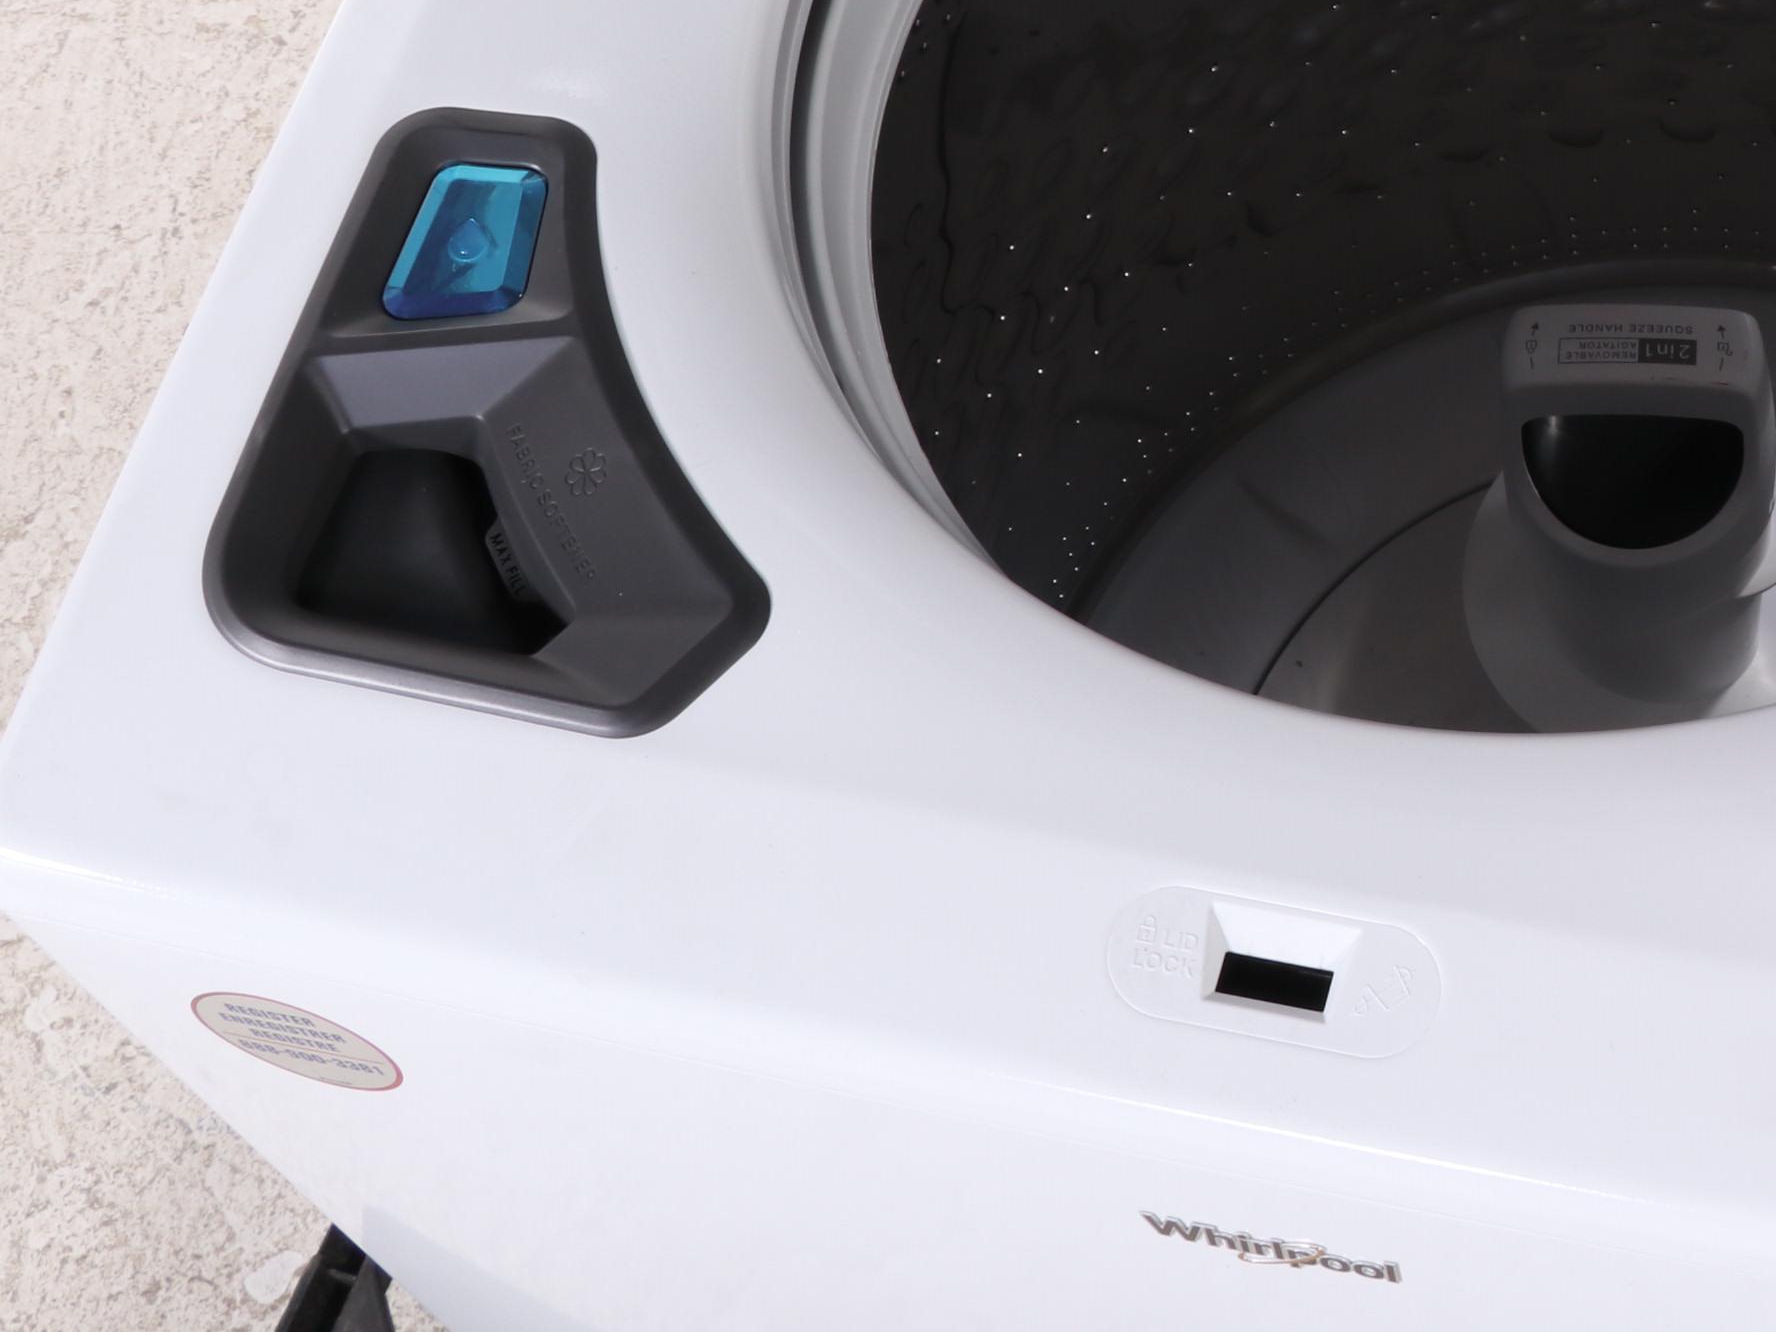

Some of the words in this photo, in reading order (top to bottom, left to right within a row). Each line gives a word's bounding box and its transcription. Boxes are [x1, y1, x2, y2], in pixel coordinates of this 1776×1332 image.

[1568, 323, 1623, 333] HANDLE
[1629, 324, 1694, 335] SQUEEZE
[1565, 351, 1637, 360] REMOVABLE
[1579, 341, 1637, 350] AGITATOR
[506, 423, 543, 490] FABRIC
[537, 488, 597, 582] SOFTENER
[489, 532, 512, 566] MAX
[505, 567, 527, 597] FILL
[1162, 928, 1199, 953] LID
[1131, 947, 1198, 979] LOCK
[217, 1012, 347, 1044] ENREGISTRER
[224, 1003, 316, 1028] REGISTER
[250, 1029, 341, 1052] REGISTRE
[1138, 1210, 1404, 1285] Whirlpool
